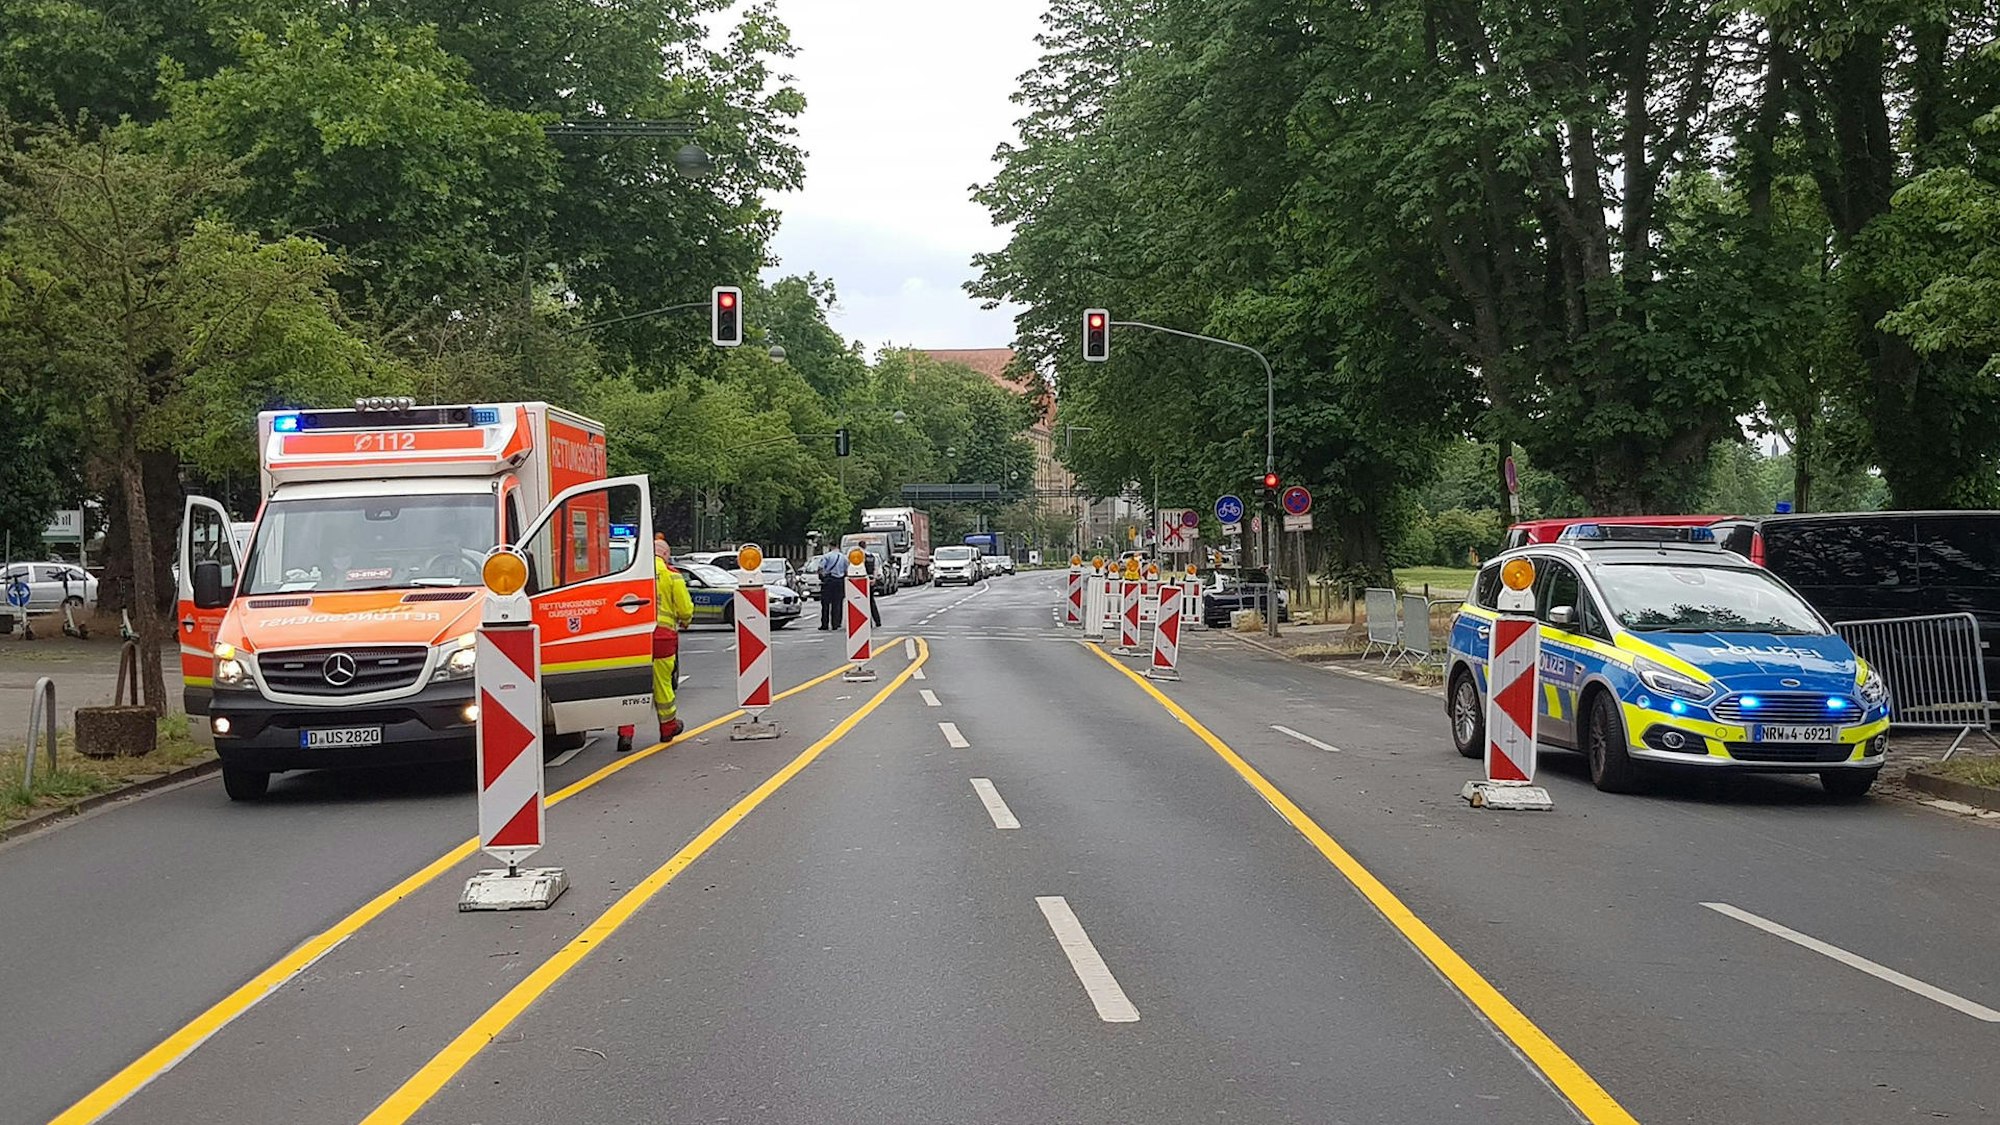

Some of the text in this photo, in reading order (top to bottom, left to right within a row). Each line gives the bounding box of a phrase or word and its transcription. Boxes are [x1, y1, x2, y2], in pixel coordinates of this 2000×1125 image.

[375, 433, 416, 451] 112
[538, 599, 608, 611] RETTUNGSDIENST
[1707, 646, 1824, 659] POLIZEI
[1539, 652, 1567, 676] OLIZEI
[310, 730, 379, 745] D US 2820
[1762, 727, 1831, 741] NRW 4-6921
